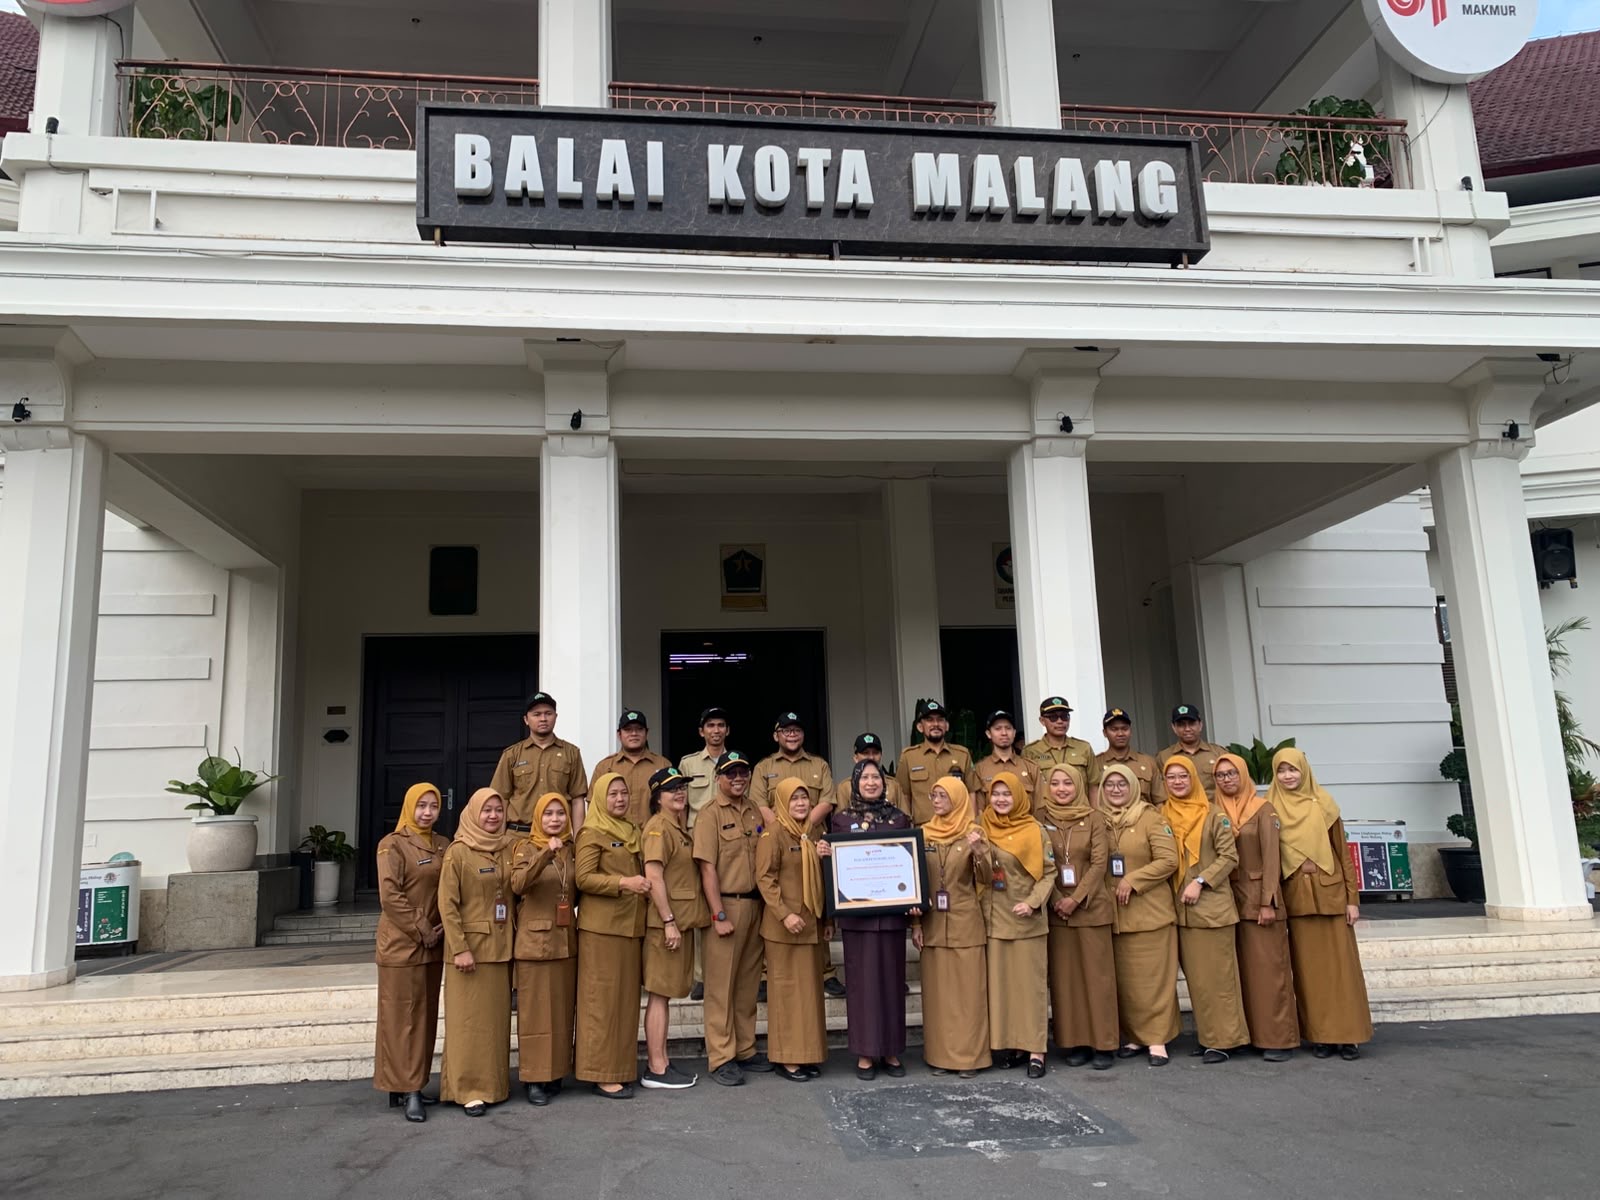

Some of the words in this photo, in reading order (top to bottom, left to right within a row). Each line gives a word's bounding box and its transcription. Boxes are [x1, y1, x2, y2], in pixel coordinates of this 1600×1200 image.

[1462, 4, 1517, 16] MAKMUR
[454, 133, 664, 203] BALAI
[707, 144, 875, 210] KOTA
[911, 152, 1179, 220] MALANG
